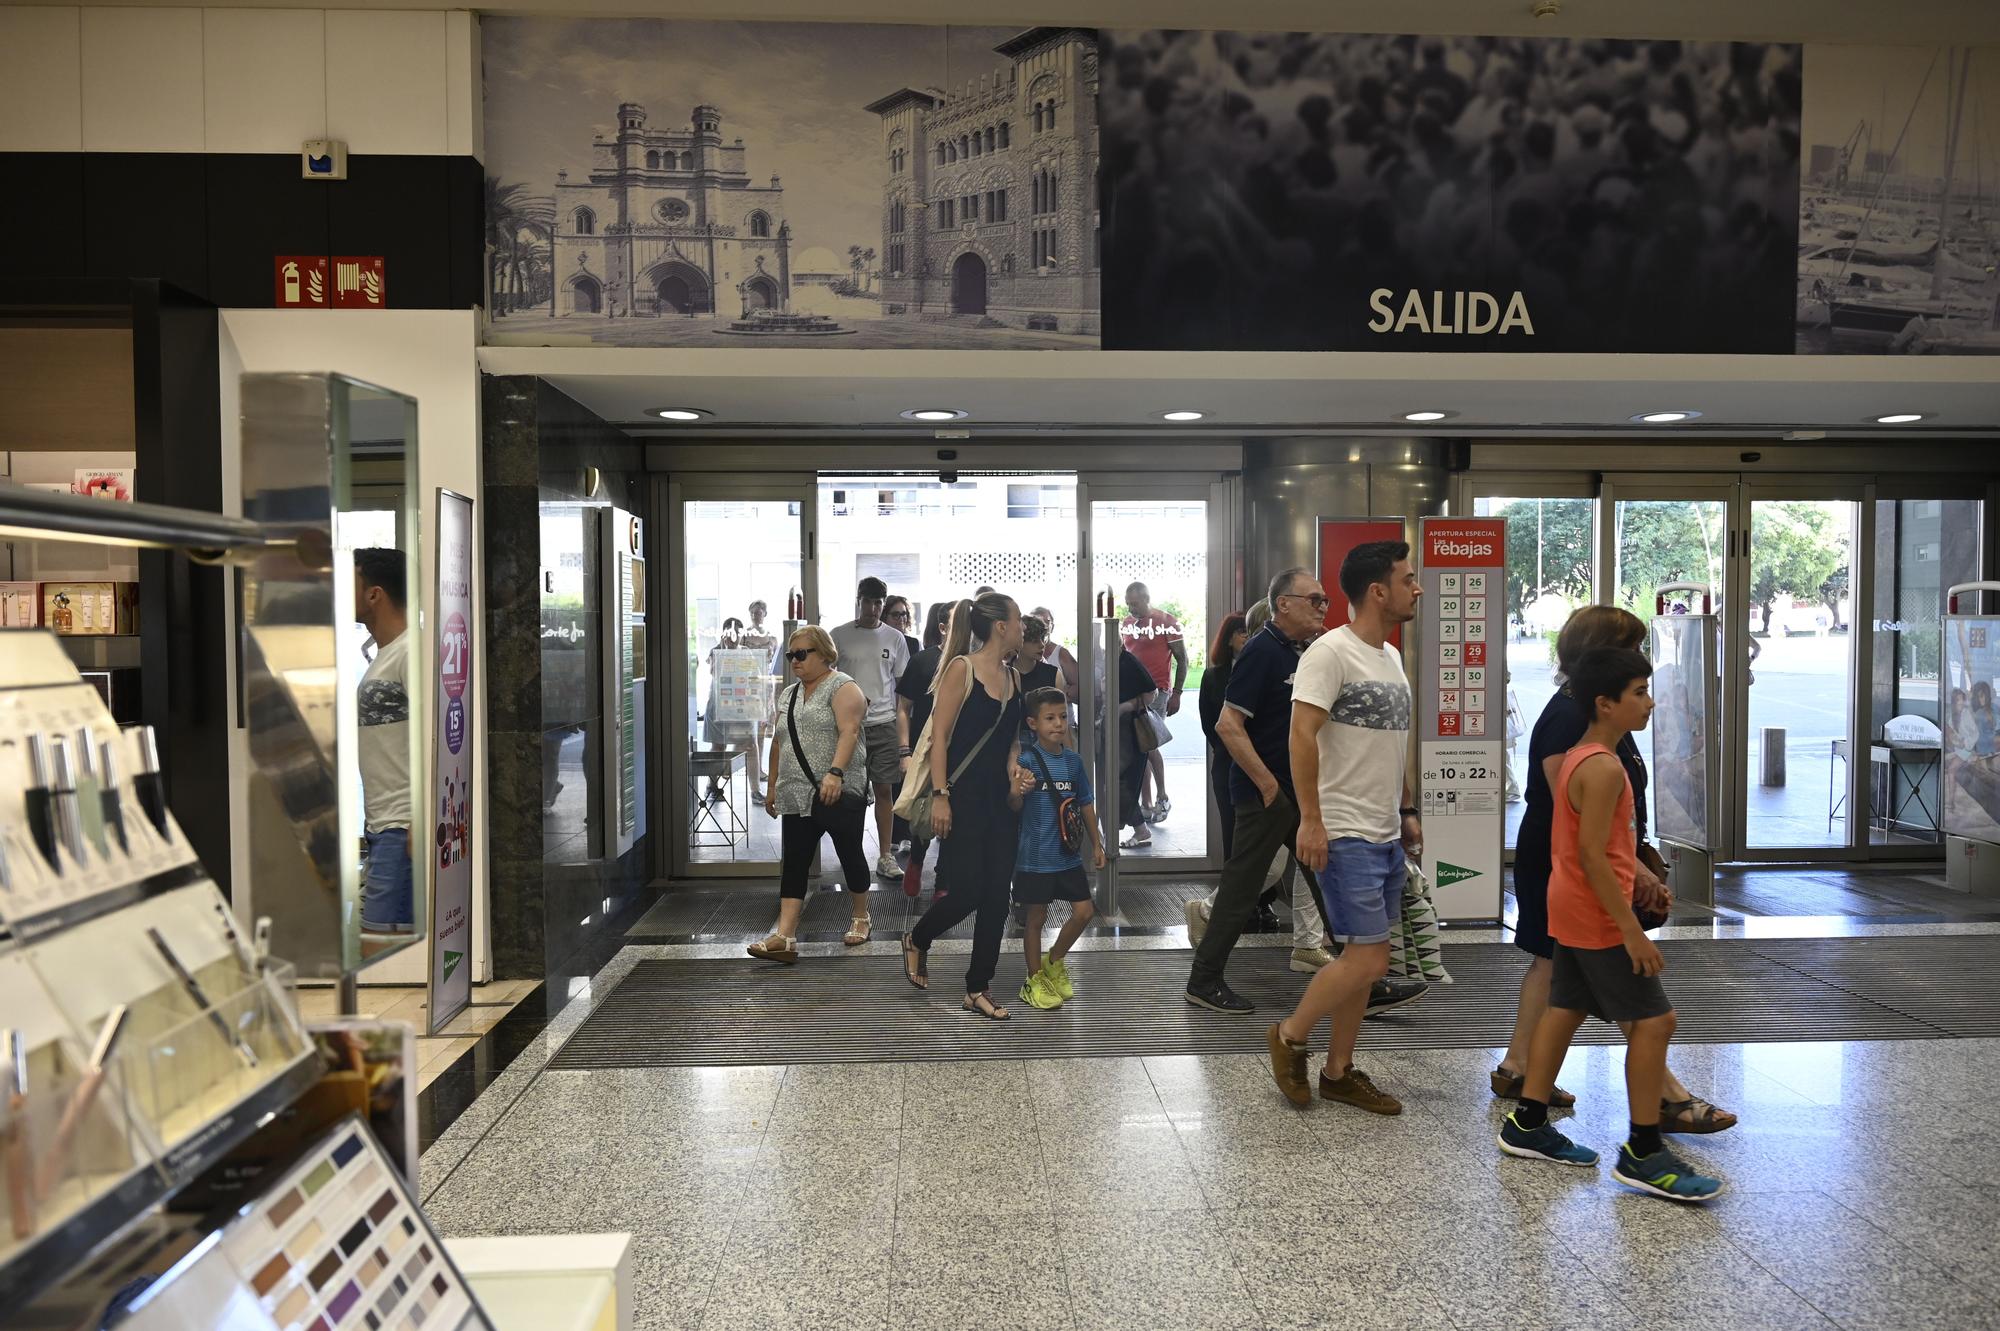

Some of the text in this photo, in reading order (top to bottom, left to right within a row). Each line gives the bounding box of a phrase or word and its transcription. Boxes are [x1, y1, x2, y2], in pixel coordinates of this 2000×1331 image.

[1368, 288, 1535, 335] SALIDA
[1433, 541, 1492, 559] rebajas
[1445, 578, 1456, 587] 19
[1469, 578, 1482, 587] 26
[1443, 601, 1457, 610] 20
[1469, 601, 1482, 610] 27
[1445, 625, 1456, 633] 21
[1469, 625, 1482, 633] 28
[1444, 648, 1456, 657] 22
[1469, 648, 1482, 657] 29
[1443, 672, 1456, 681] 23
[1468, 672, 1482, 681] 30
[1443, 694, 1456, 703] 24
[1472, 694, 1477, 703] 1
[1443, 717, 1456, 726] 25
[1471, 717, 1478, 726] 2
[1423, 771, 1437, 780] de
[1440, 768, 1456, 779] 10
[1469, 768, 1486, 779] 22
[1489, 769, 1499, 779] h.
